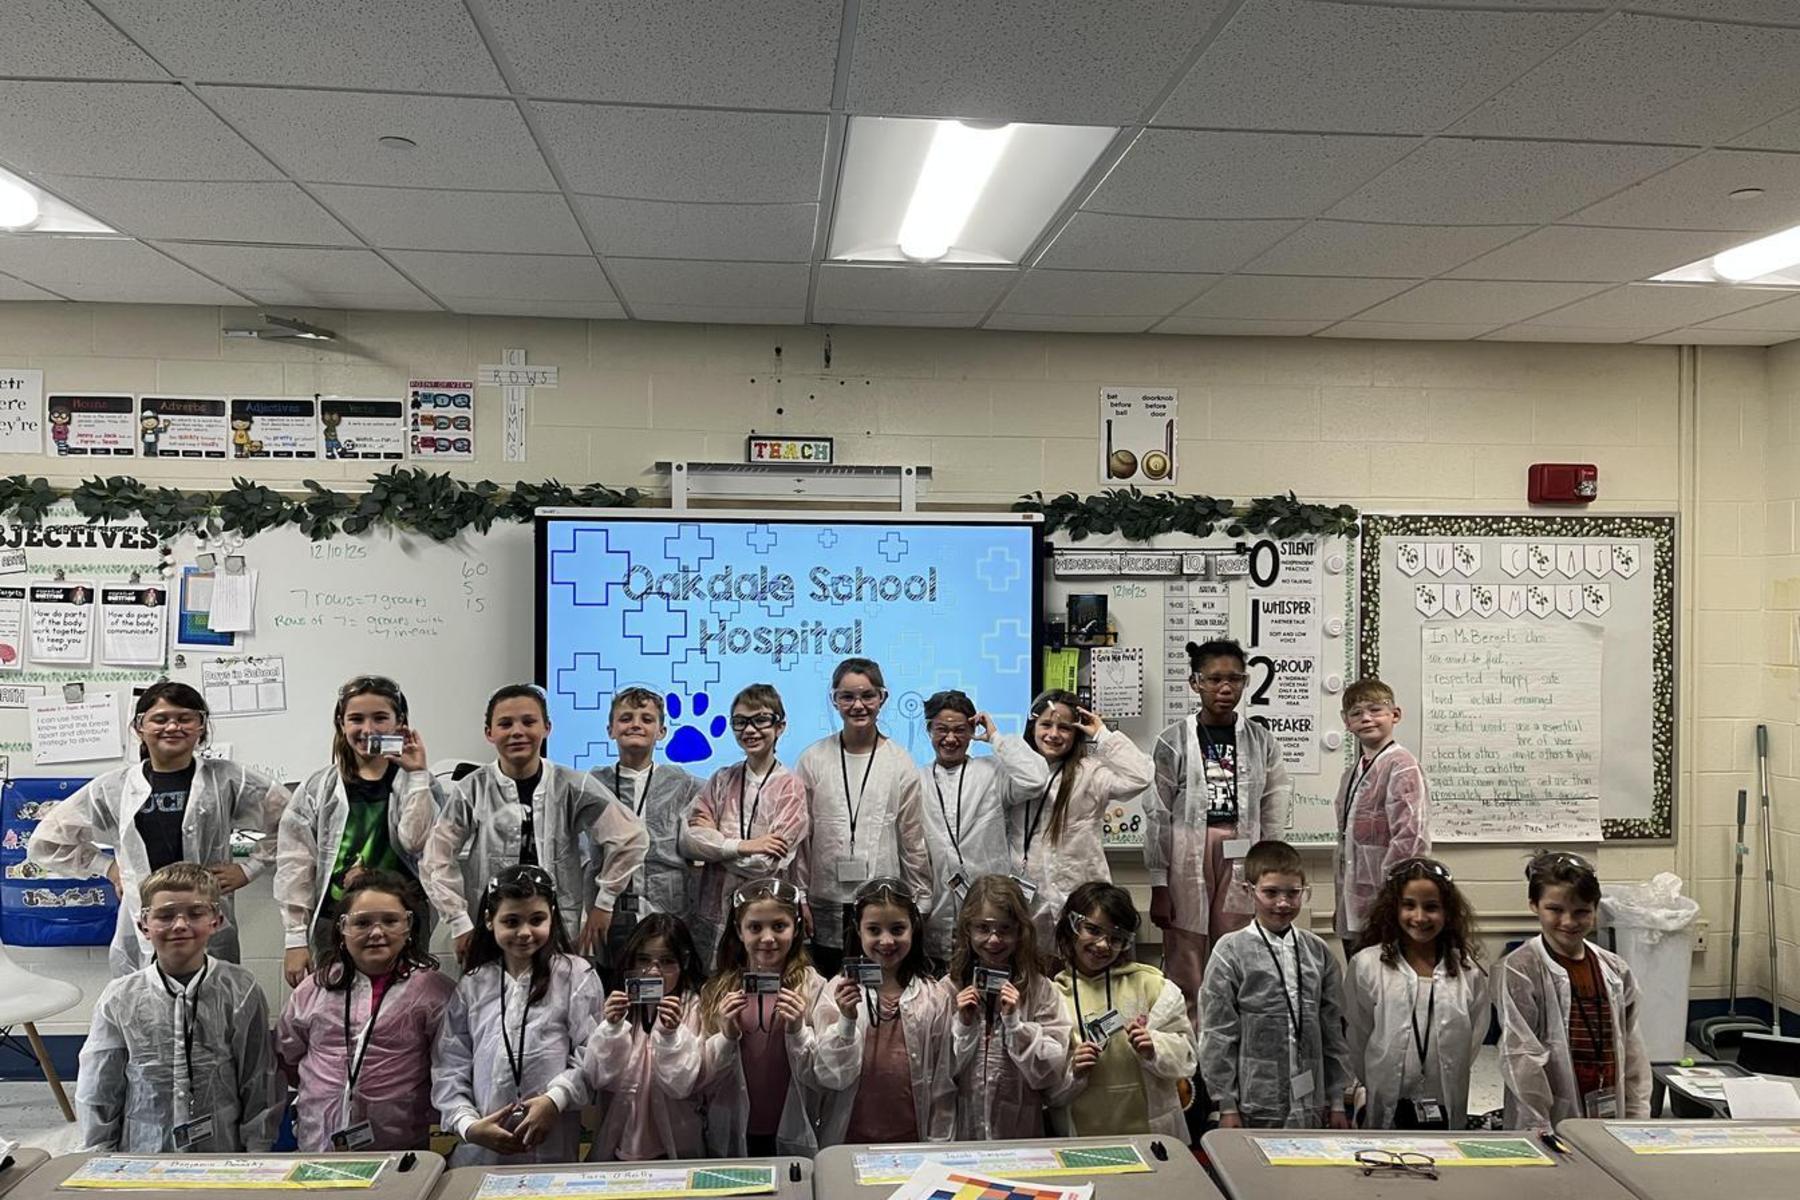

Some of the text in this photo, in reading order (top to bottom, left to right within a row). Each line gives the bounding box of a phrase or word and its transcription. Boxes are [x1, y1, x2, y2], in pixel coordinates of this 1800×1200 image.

[493, 370, 548, 385] ROWS
[160, 401, 208, 412] Adverbs
[754, 442, 828, 459] TEACH
[310, 544, 368, 559] 12/10/25
[1121, 557, 1179, 572] DECEMBER
[1249, 538, 1315, 588] 0 SILENT
[1511, 549, 1633, 572] CLASS
[461, 561, 489, 578] 60
[462, 581, 475, 595] 5
[622, 564, 937, 602] Oakdale School
[465, 598, 486, 612] 15
[1262, 600, 1311, 614] WHISPER
[65, 611, 87, 619] parts
[137, 612, 158, 620] parts
[312, 614, 323, 625] of
[36, 618, 45, 626] of
[63, 619, 83, 628] body
[135, 621, 154, 629] body
[52, 628, 87, 637] together
[1430, 627, 1448, 643] In
[46, 636, 65, 645] keep
[700, 618, 862, 664] Hospital
[1097, 654, 1110, 662] Give
[205, 670, 231, 681] Days
[243, 666, 281, 678] School
[1500, 669, 1529, 692] happy
[1248, 656, 1312, 706] 2 GROUP
[59, 722, 74, 730] and
[89, 719, 110, 728] break
[1455, 720, 1474, 731] kind
[38, 727, 109, 740] apart and distribute
[1536, 735, 1548, 746] of
